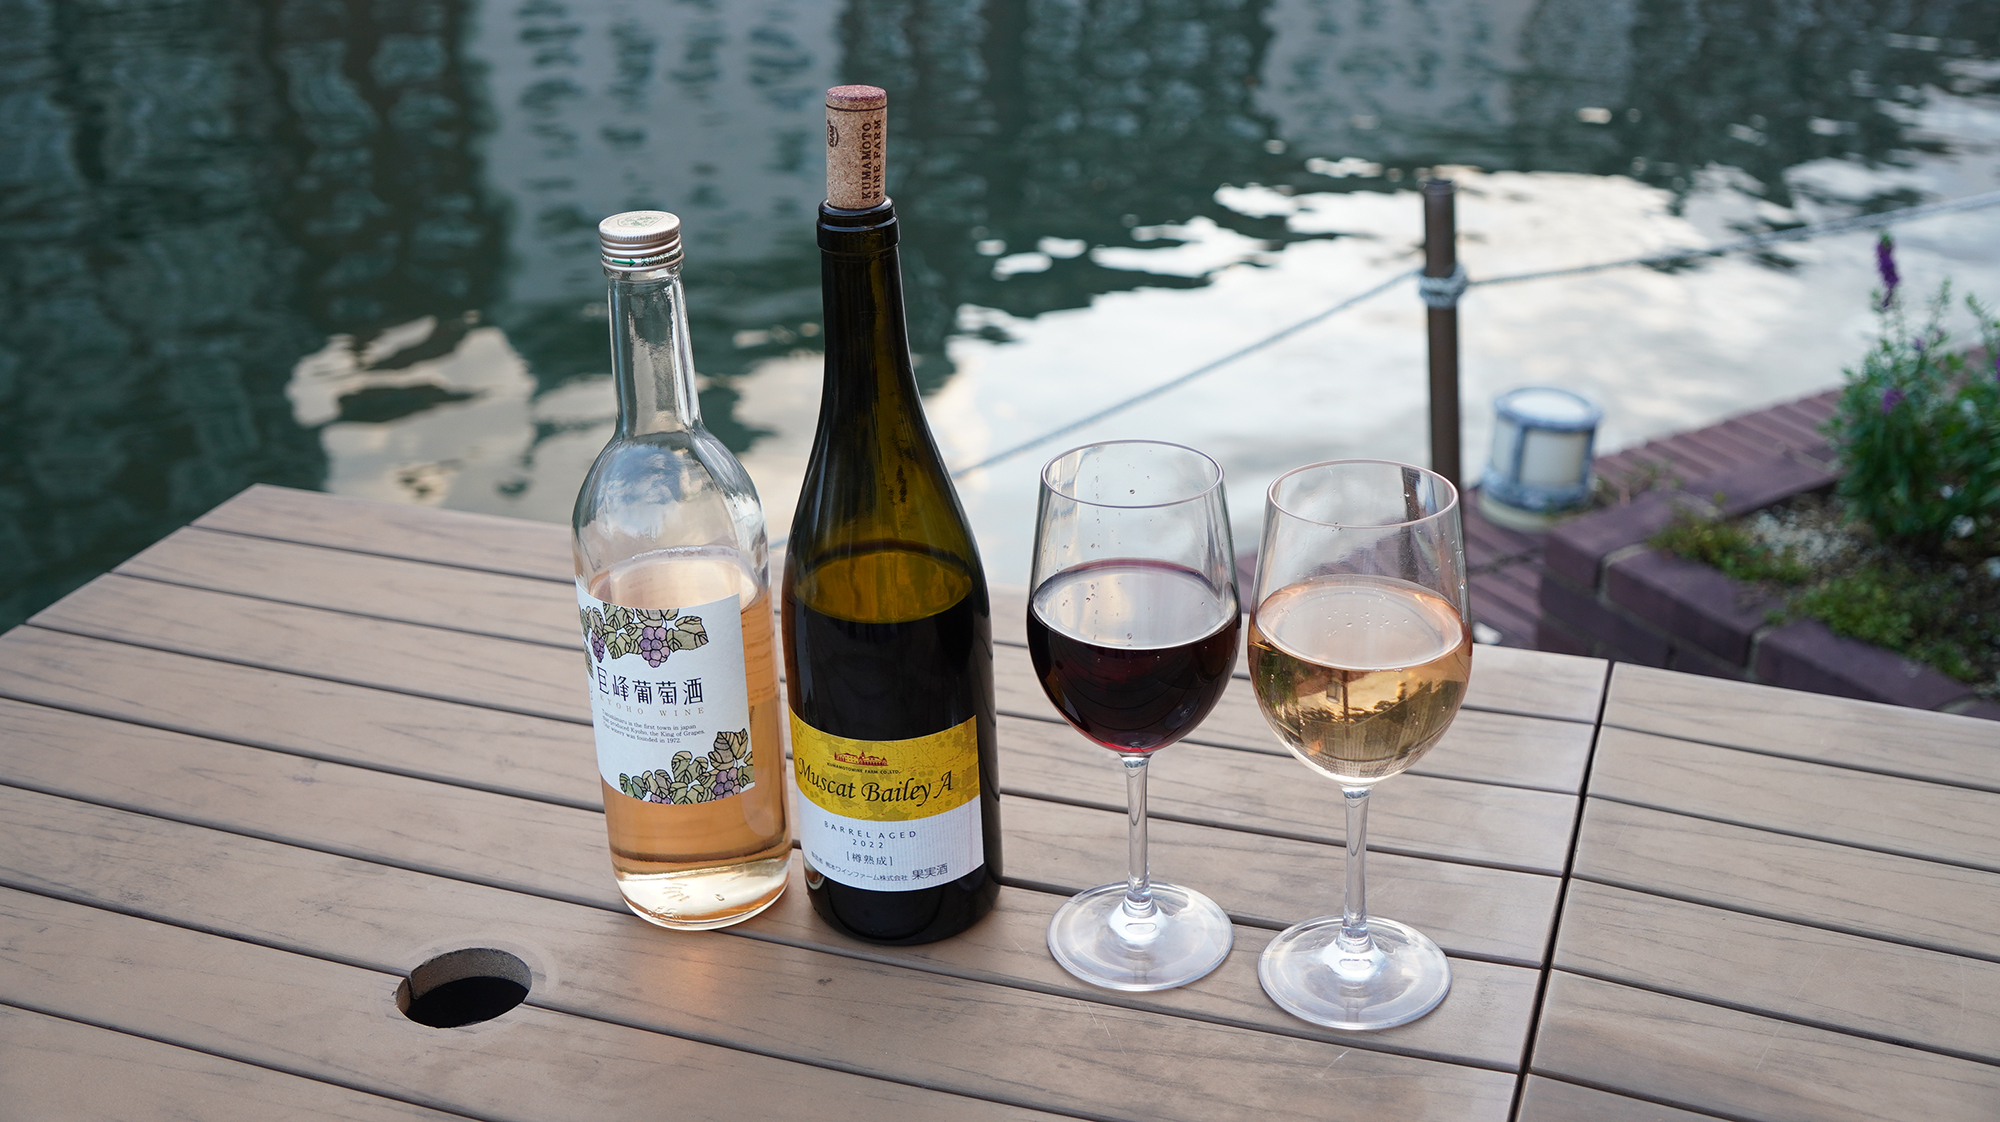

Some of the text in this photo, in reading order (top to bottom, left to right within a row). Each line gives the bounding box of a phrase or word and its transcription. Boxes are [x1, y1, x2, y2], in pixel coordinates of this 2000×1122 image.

[861, 122, 872, 200] KUMAMOTO
[873, 119, 882, 200] WINE FARM
[596, 665, 704, 706] 巨峰葡萄酒
[599, 693, 644, 715] KYOHO
[659, 706, 705, 717] WINE
[637, 735, 658, 743] founded
[798, 757, 954, 807] Muscat Bailey A
[824, 820, 917, 839] BARREL AGED
[852, 838, 884, 849] 2022
[911, 862, 948, 881] 果実酒
